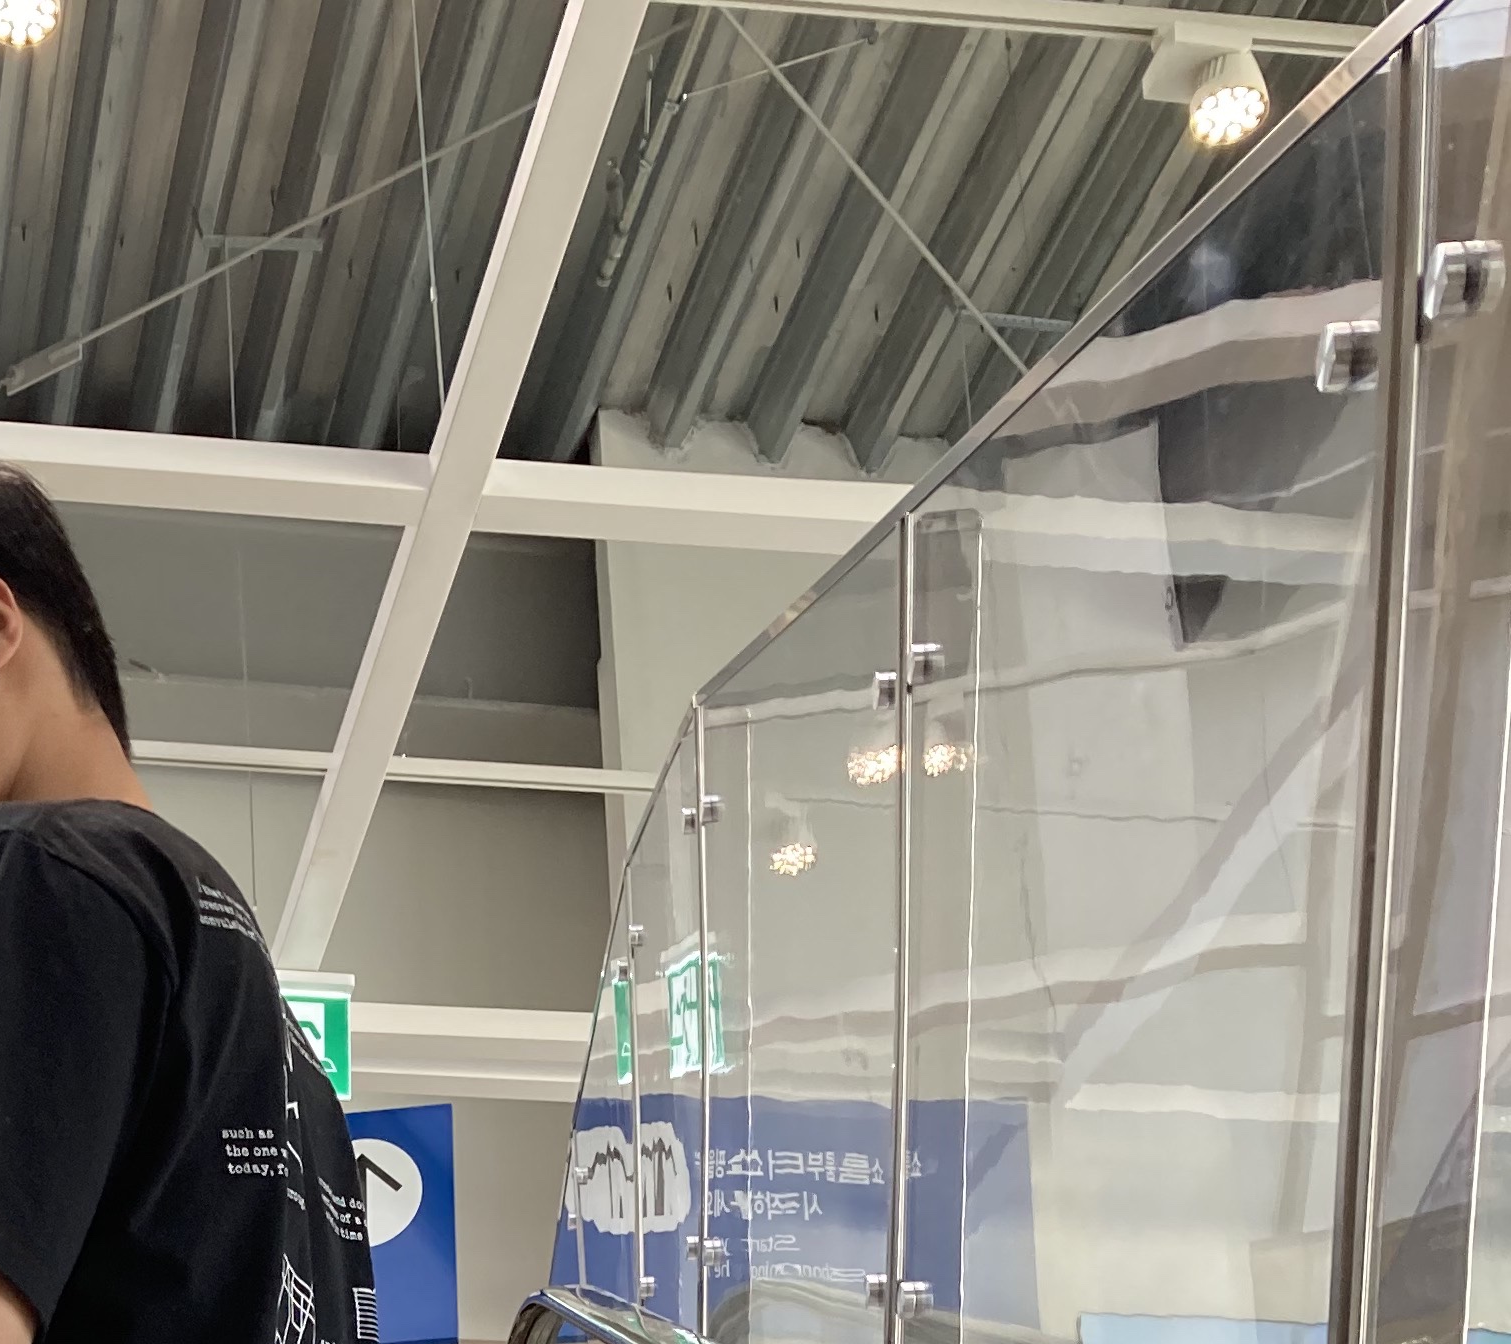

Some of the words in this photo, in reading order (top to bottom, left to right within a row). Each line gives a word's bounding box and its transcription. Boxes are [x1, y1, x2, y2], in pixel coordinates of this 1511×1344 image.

[221, 1127, 254, 1139] such
[258, 1129, 274, 1139] as
[225, 1144, 249, 1157] the
[254, 1146, 278, 1157] one
